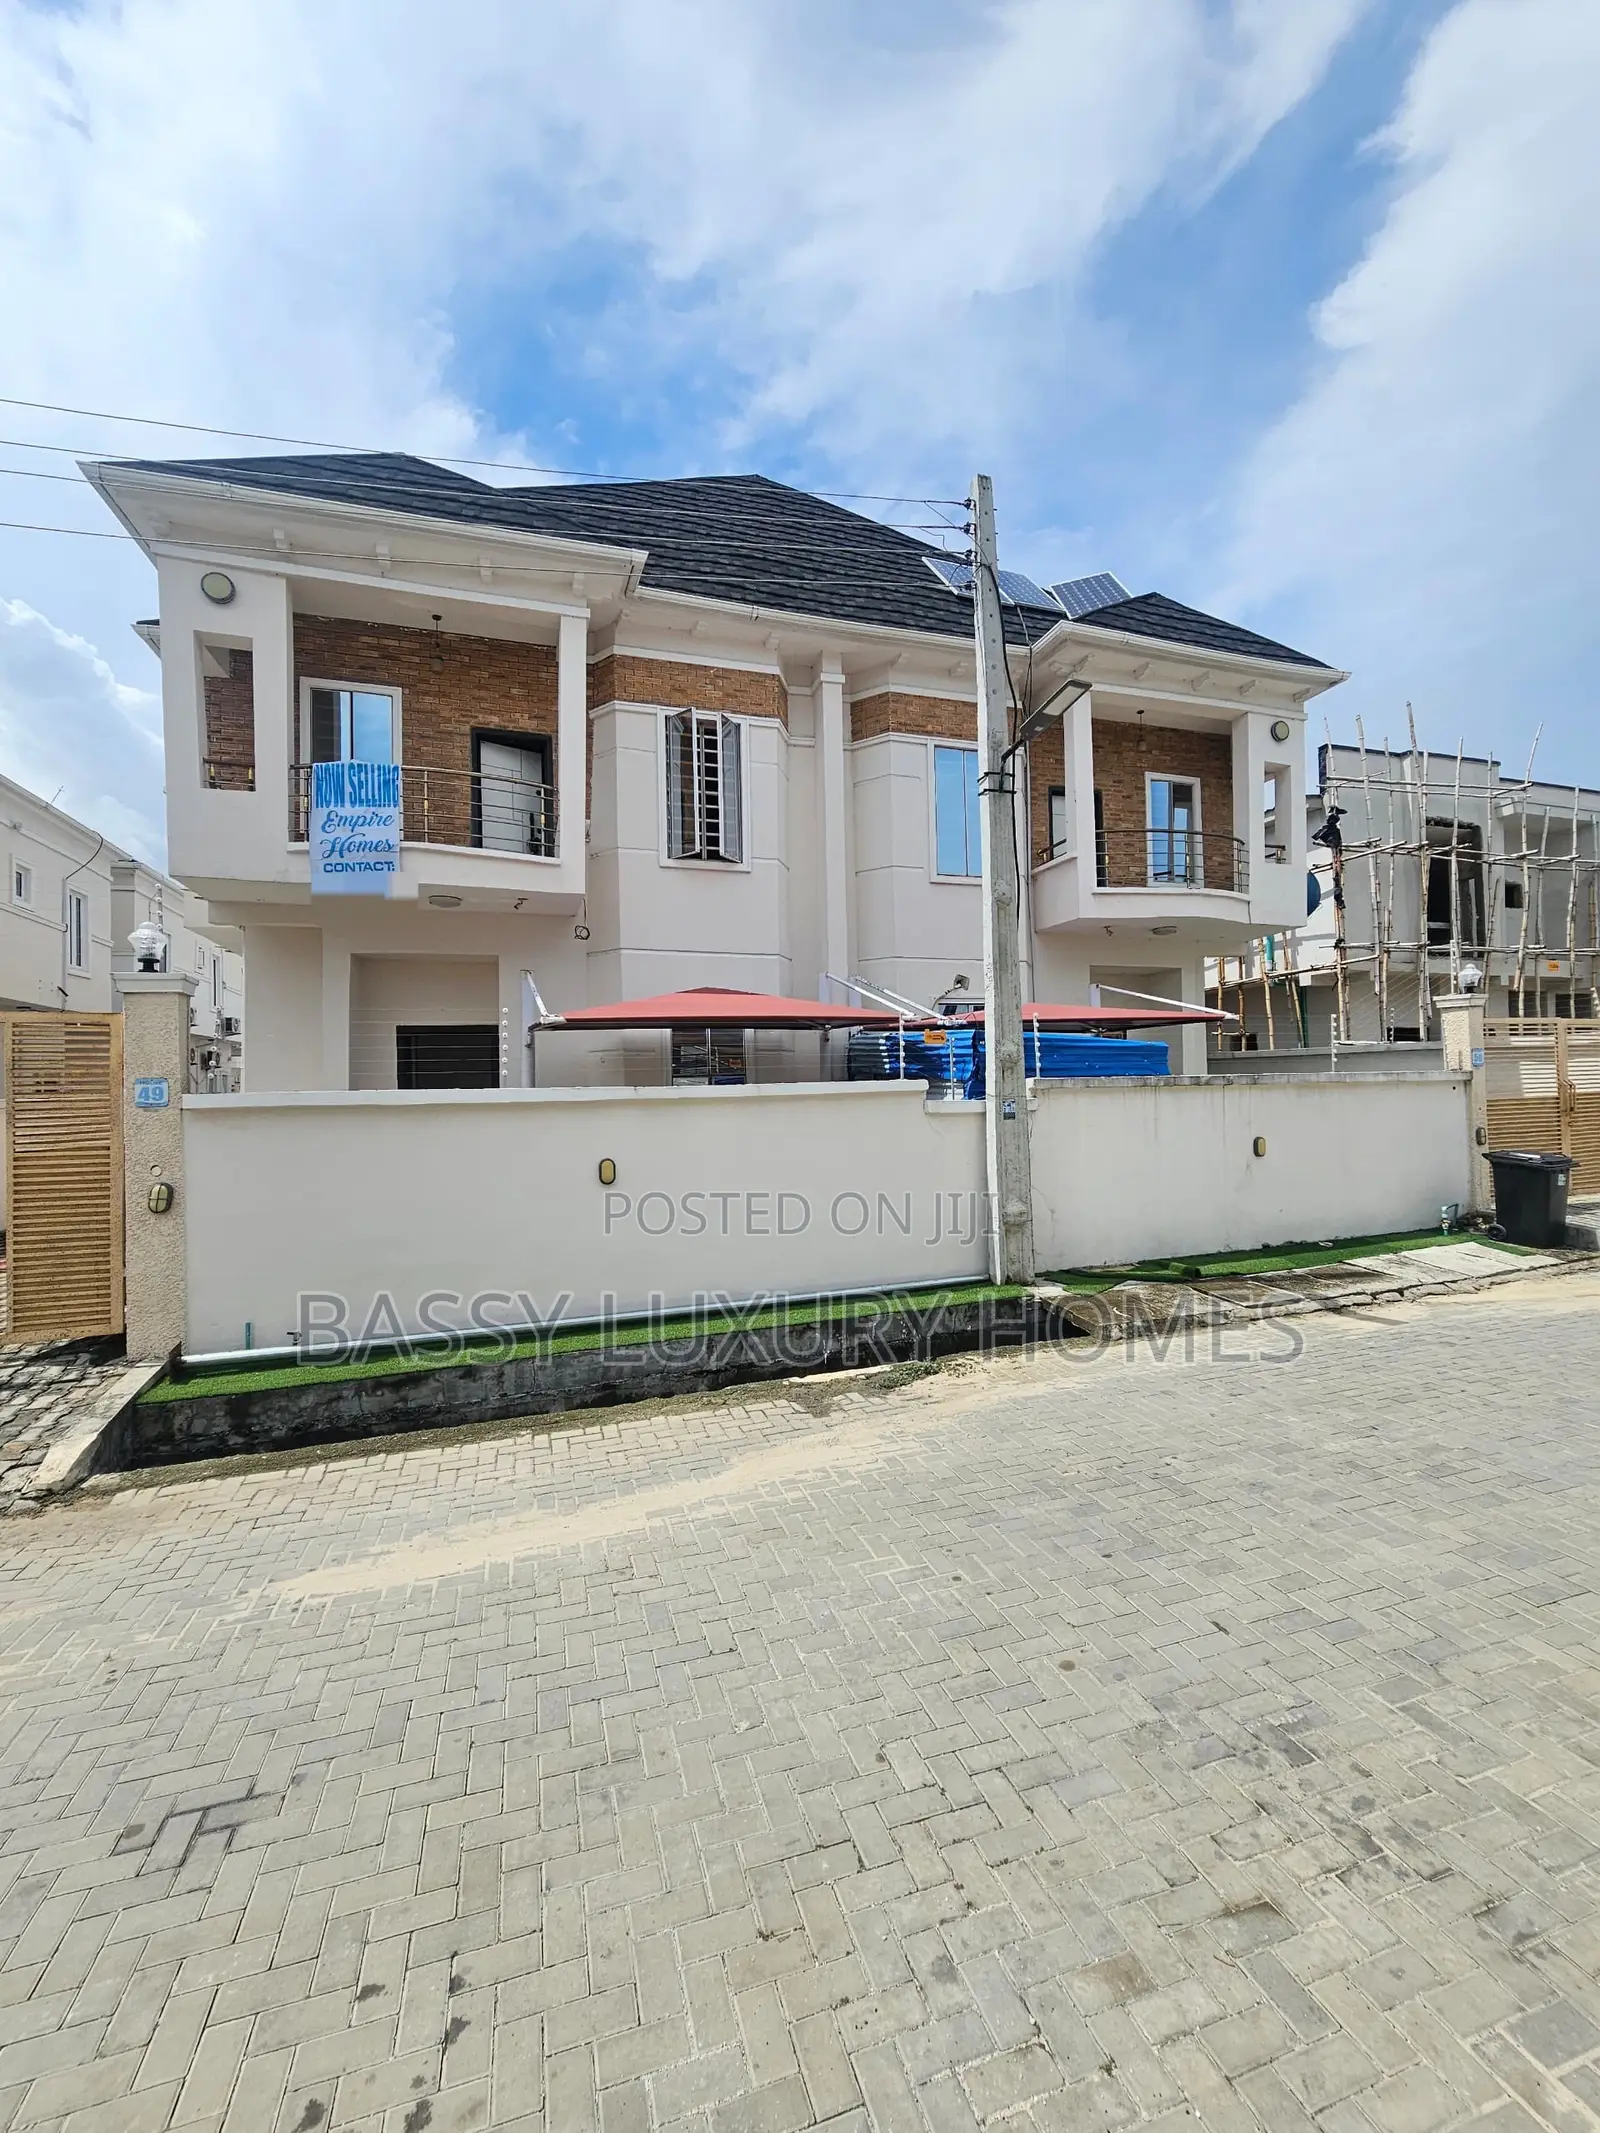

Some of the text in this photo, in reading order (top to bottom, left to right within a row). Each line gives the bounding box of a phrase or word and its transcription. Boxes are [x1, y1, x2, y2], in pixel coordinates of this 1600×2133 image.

[315, 762, 345, 808] NOW
[321, 810, 395, 833] Empire
[319, 833, 397, 859] Homes
[323, 861, 395, 873] CONTACT:
[138, 1086, 164, 1101] 49
